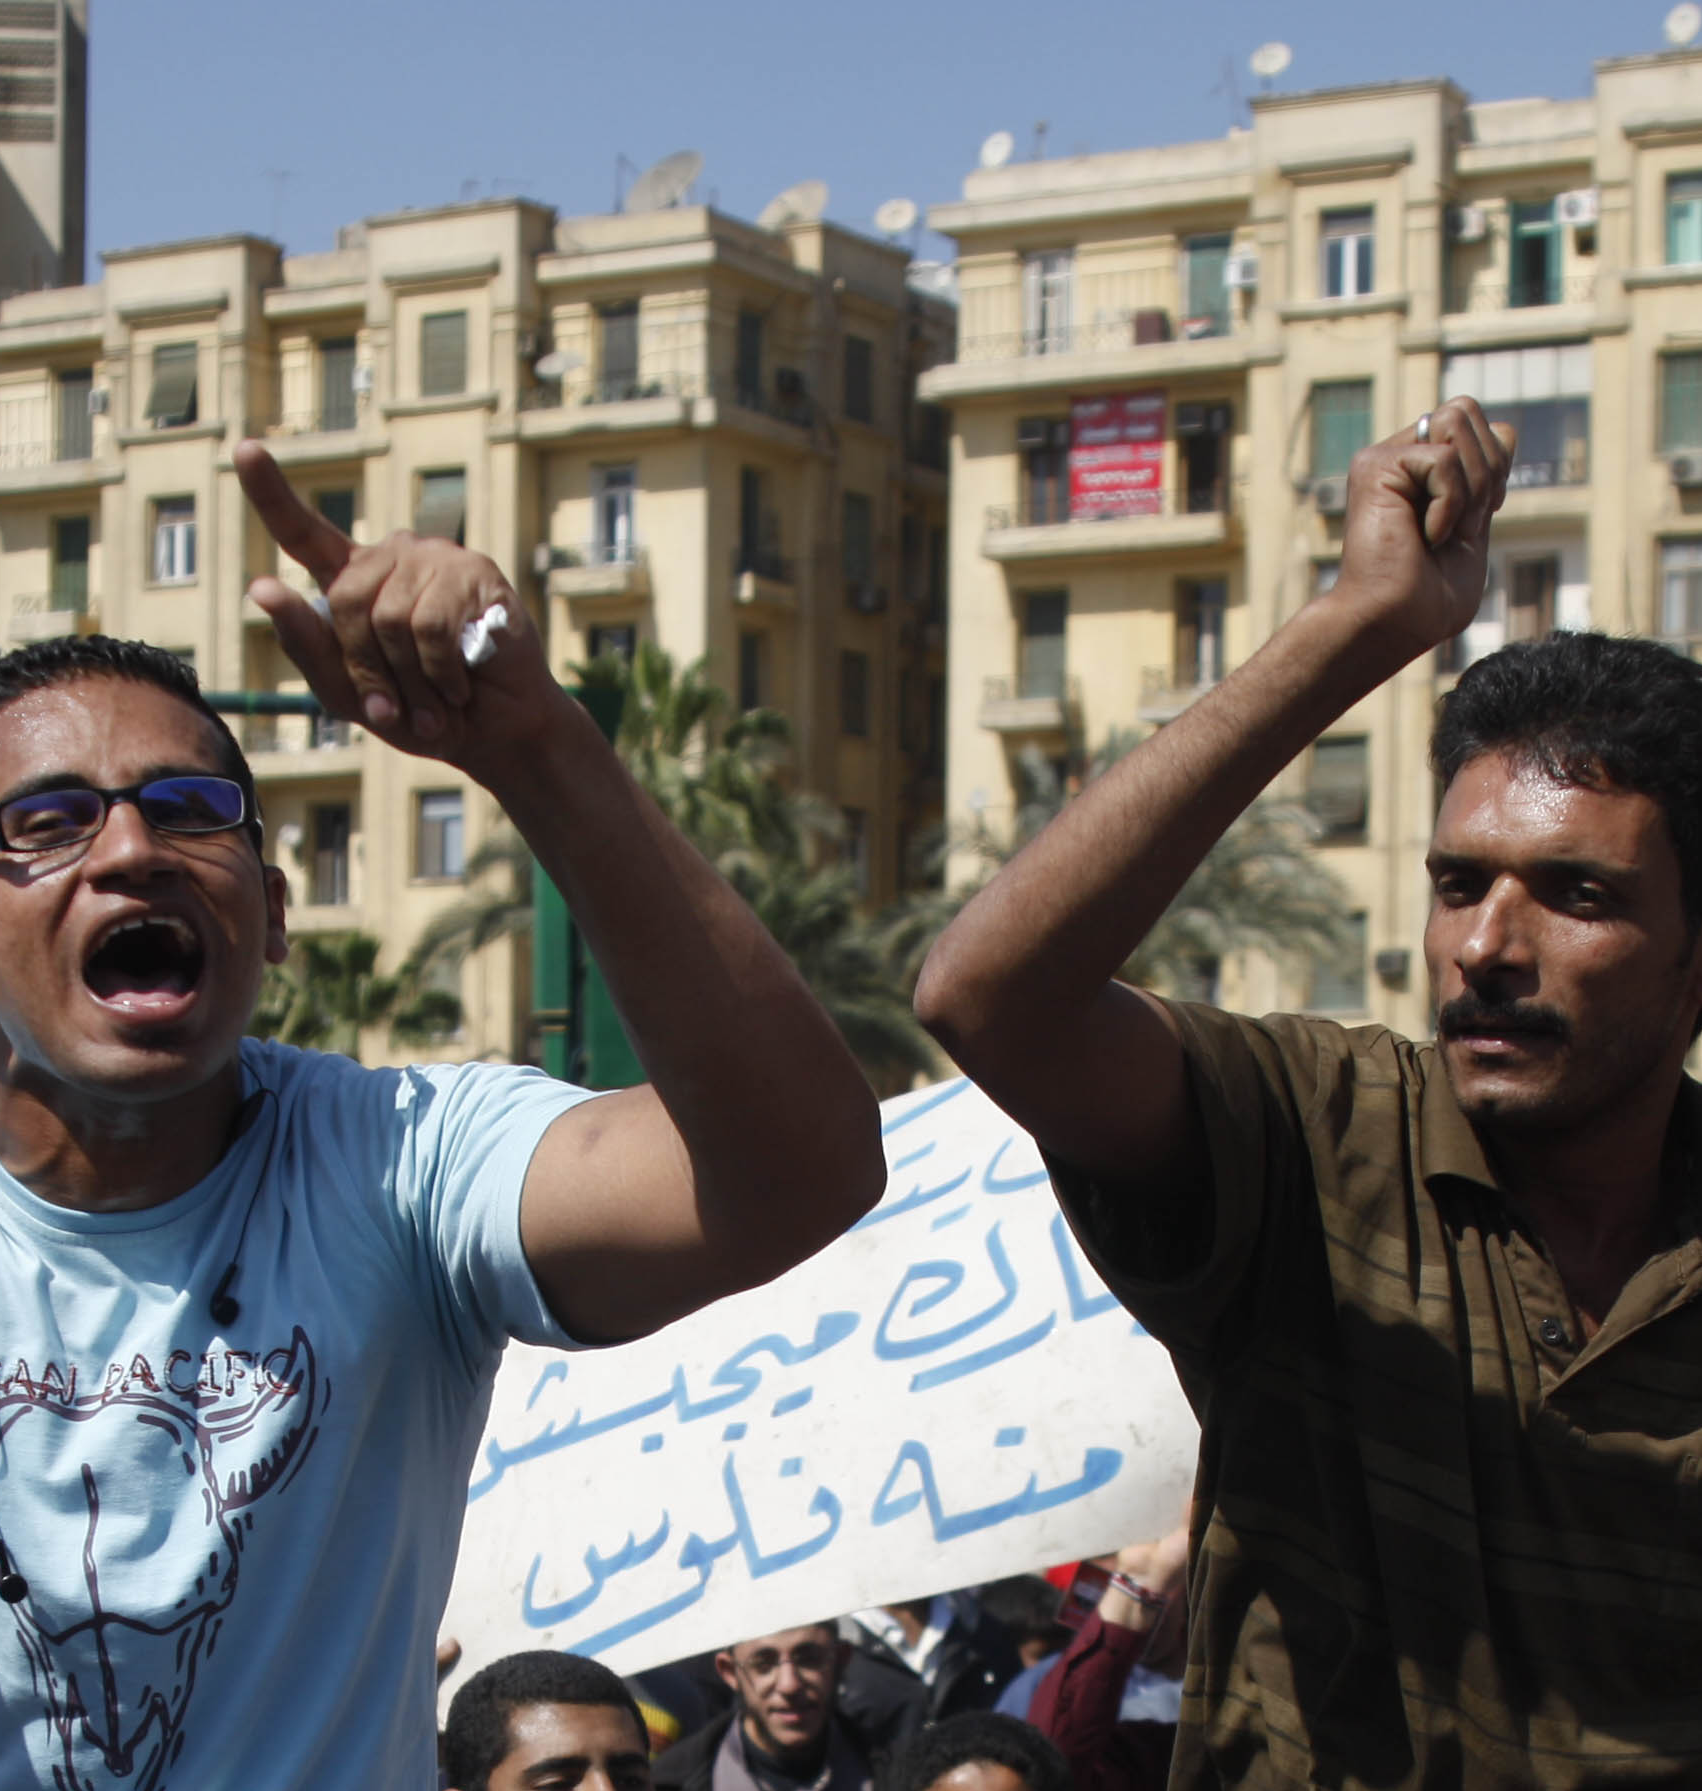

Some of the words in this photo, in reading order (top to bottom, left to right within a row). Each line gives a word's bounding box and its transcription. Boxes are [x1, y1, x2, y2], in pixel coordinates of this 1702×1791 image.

[100, 1347, 298, 1403] PACIFIC
[870, 1425, 1125, 1544] منه
[520, 1449, 844, 1658] فلوس
